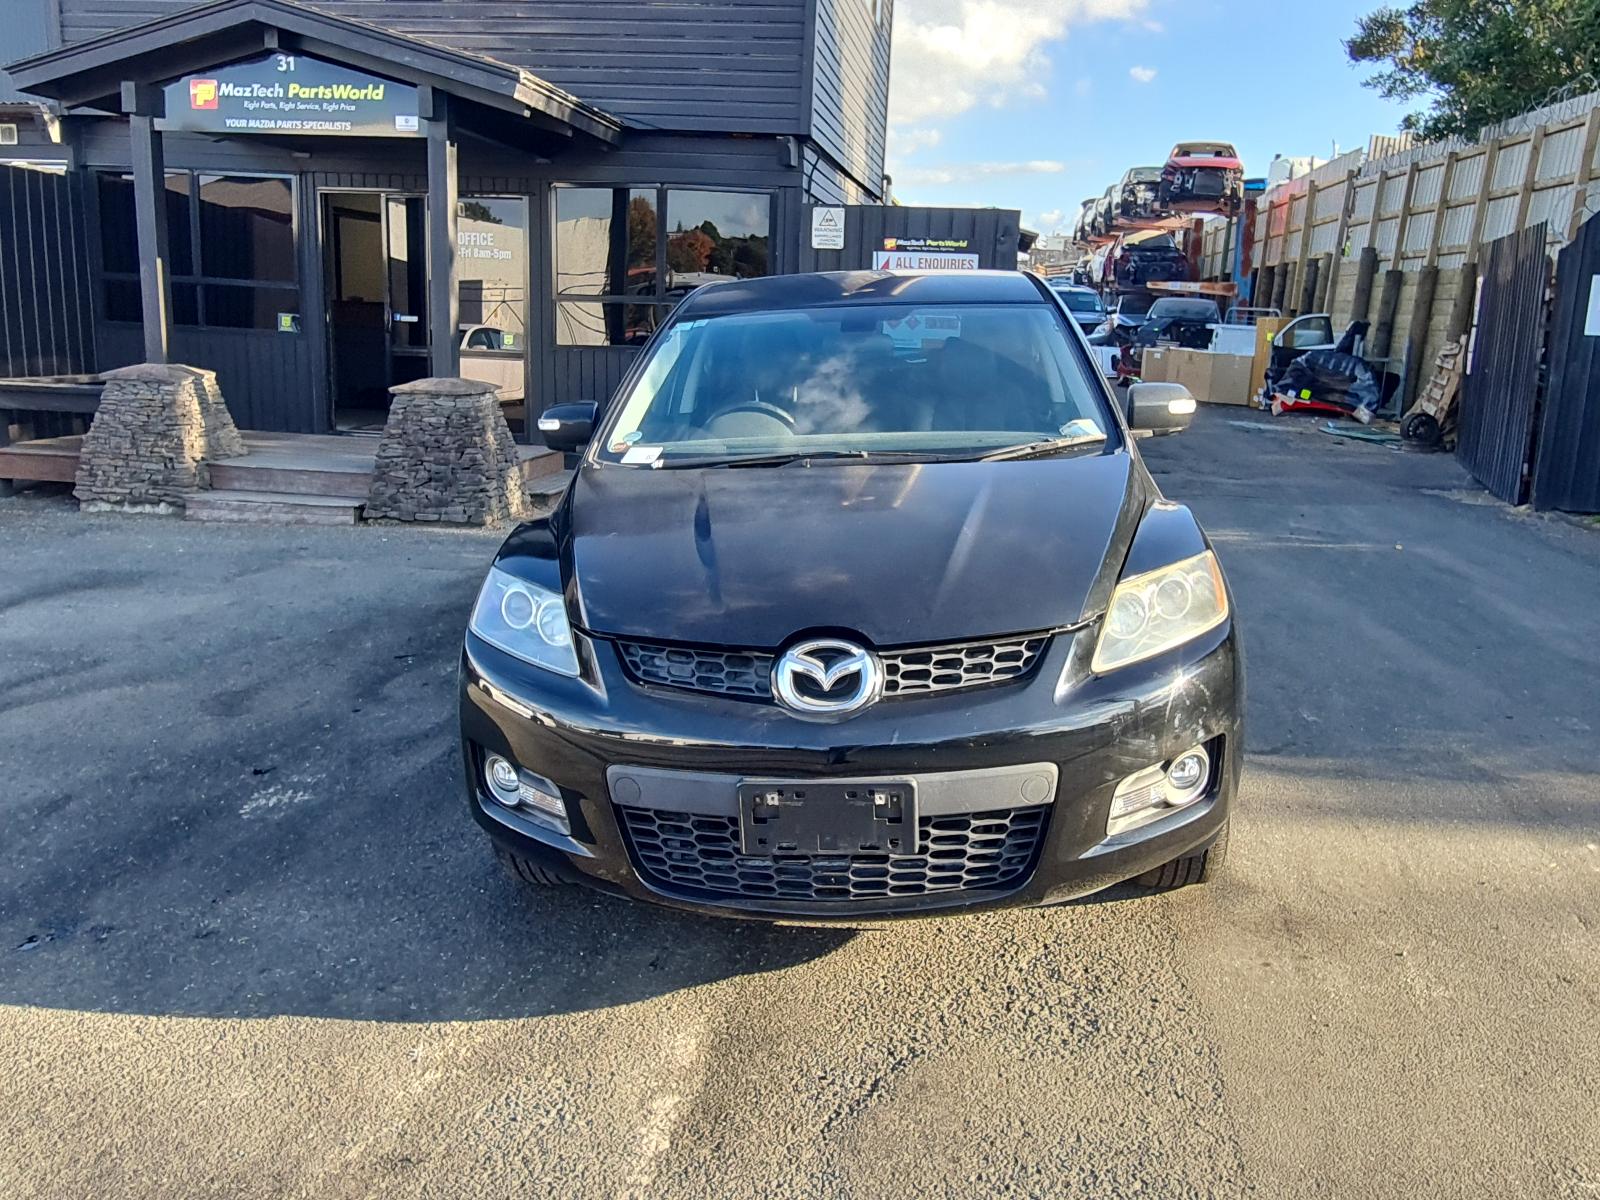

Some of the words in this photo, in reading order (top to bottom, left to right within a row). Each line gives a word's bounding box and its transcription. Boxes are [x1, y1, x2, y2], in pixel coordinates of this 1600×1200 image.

[276, 56, 295, 71] 31
[219, 82, 284, 98] MazTech
[288, 83, 385, 100] PartsWorld
[243, 101, 260, 111] Right
[279, 102, 296, 111] Right
[297, 103, 321, 112] Service,
[322, 102, 339, 112] Right
[339, 103, 356, 111] Price
[225, 118, 247, 128] YOUR
[248, 119, 276, 129] MAZDA
[277, 120, 301, 129] PARTS
[303, 120, 352, 131] SPECIALISTS
[457, 232, 494, 246] OFFICE
[926, 240, 968, 248] PartsWorld
[473, 248, 512, 260] 8am-5pm
[895, 257, 914, 269] ALL
[918, 257, 974, 270] ENQUIRIES
